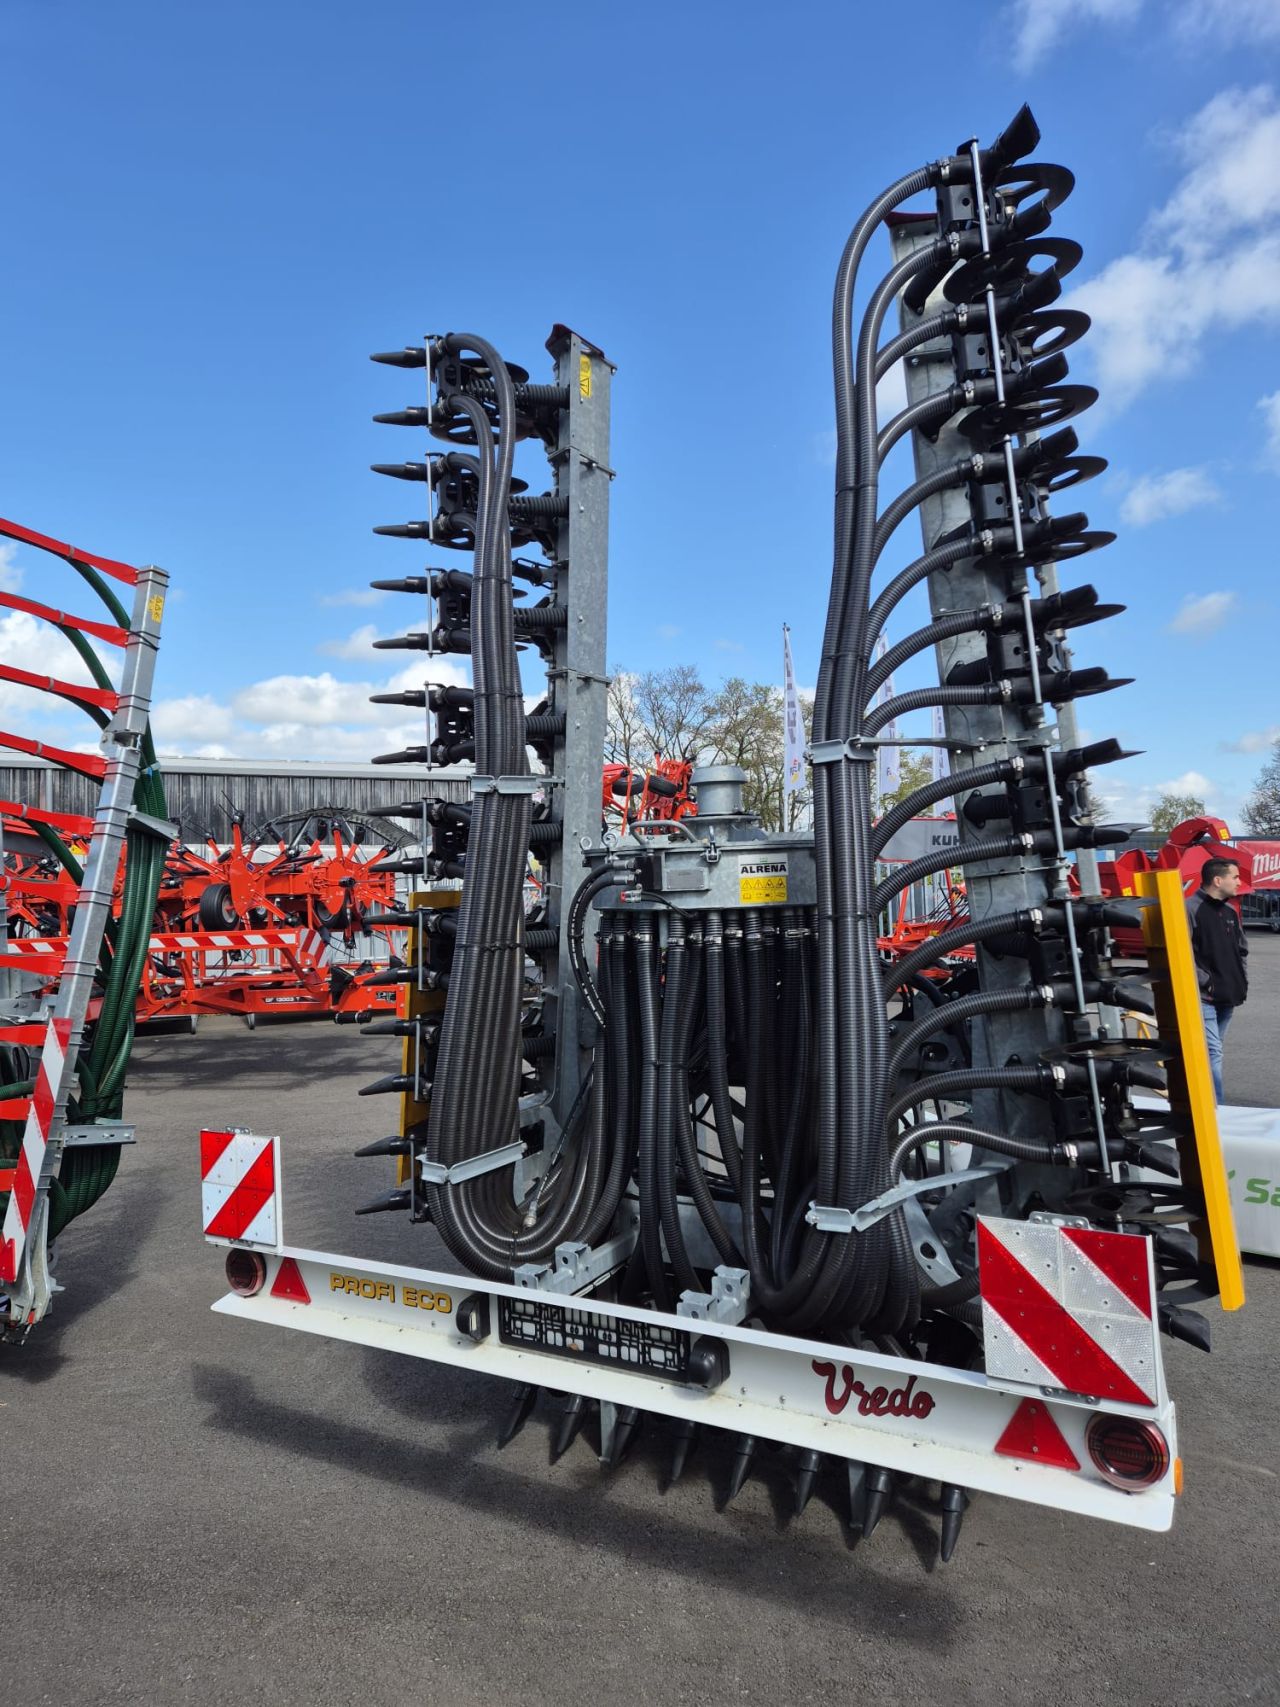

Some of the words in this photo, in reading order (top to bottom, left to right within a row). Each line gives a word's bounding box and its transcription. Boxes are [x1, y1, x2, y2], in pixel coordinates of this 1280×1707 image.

[932, 835, 960, 846] KUH
[740, 864, 787, 874] ALRENA
[1252, 853, 1280, 876] Mil
[329, 1273, 395, 1304] PROFI
[402, 1286, 453, 1314] ECO
[811, 1358, 936, 1420] Vredo
